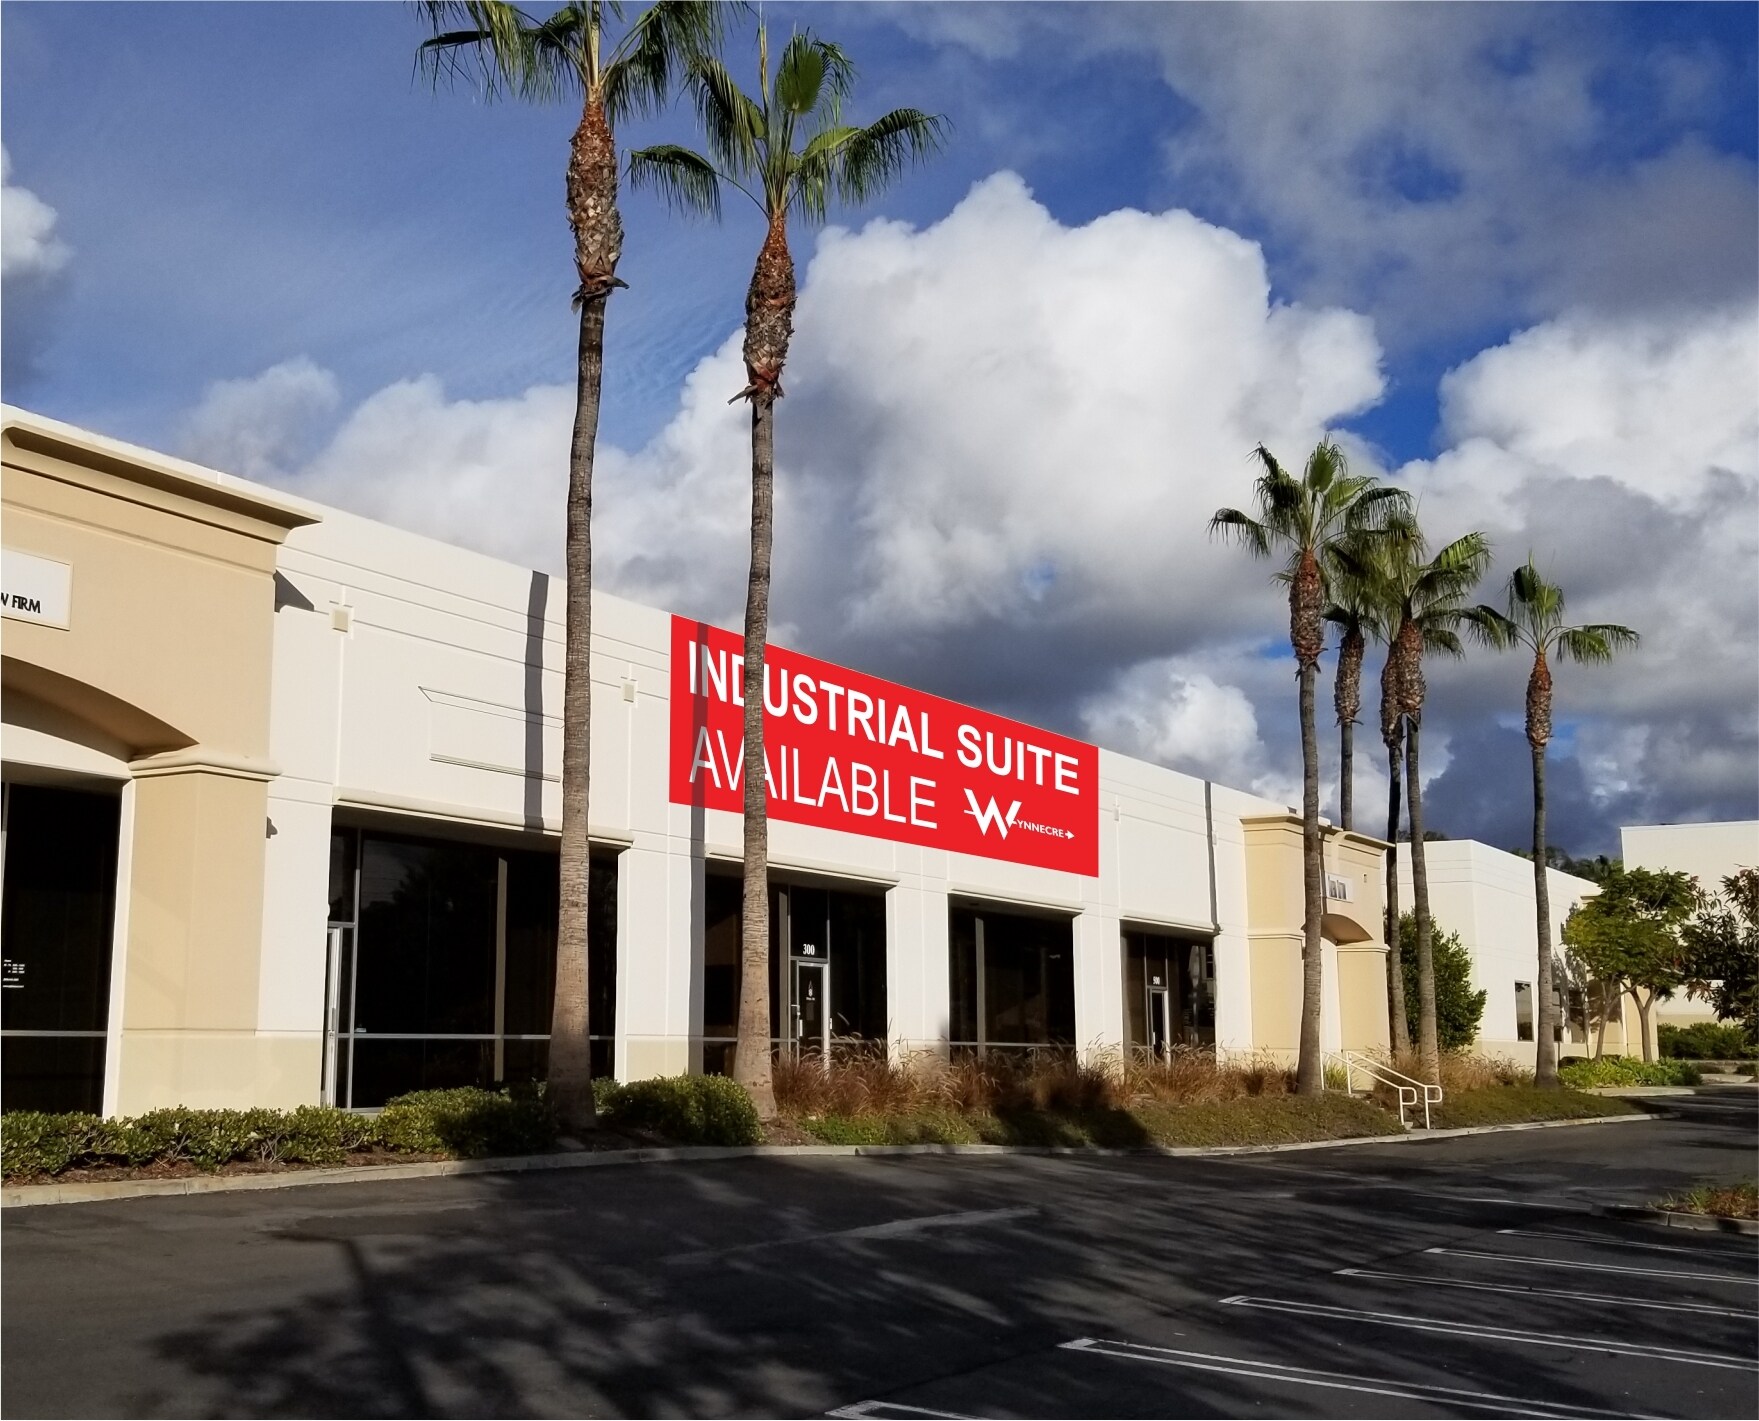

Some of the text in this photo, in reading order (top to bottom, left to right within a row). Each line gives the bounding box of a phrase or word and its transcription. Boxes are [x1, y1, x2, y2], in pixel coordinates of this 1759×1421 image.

[12, 594, 41, 614] FIRM
[957, 724, 1080, 796] SUITE
[802, 943, 816, 956] 300
